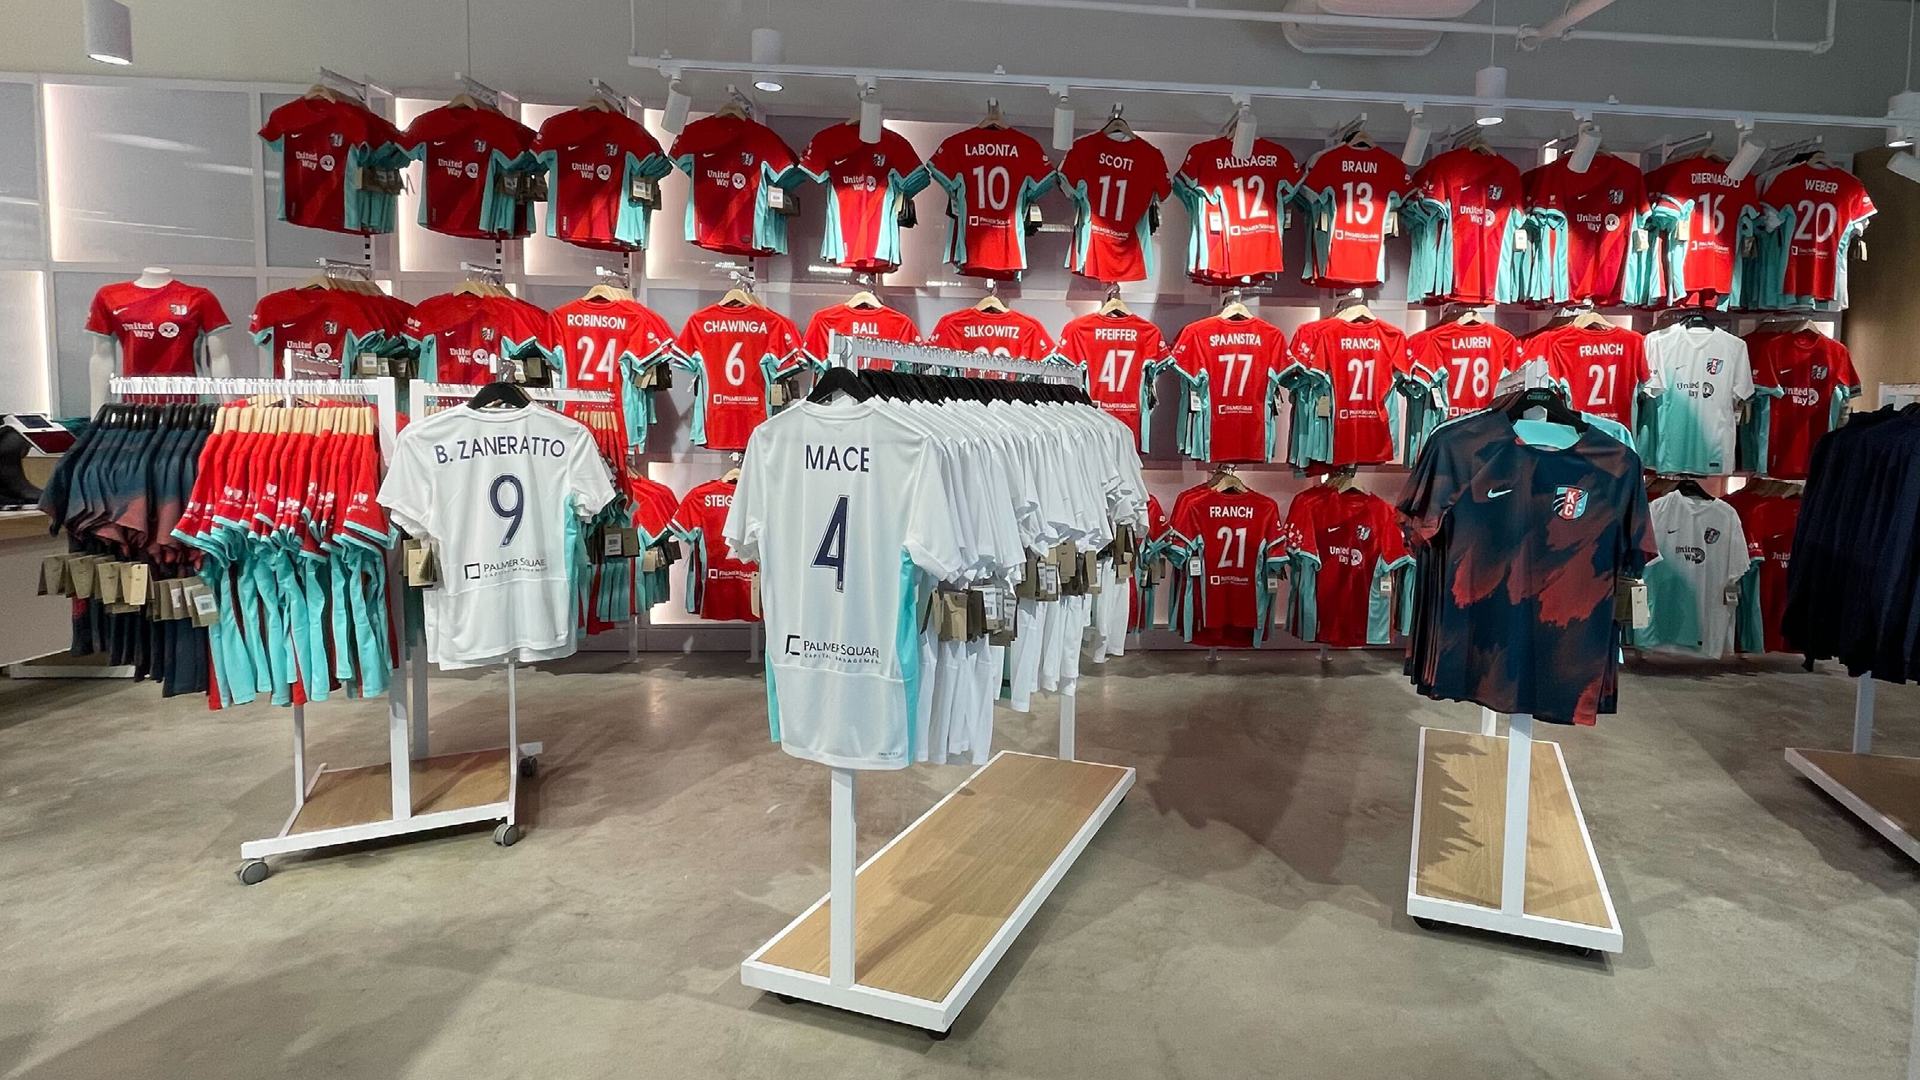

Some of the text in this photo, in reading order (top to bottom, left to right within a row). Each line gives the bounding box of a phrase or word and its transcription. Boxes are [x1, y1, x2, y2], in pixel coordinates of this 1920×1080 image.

[438, 159, 462, 168] United
[572, 163, 594, 172] United
[1099, 153, 1133, 171] SCOTT
[1216, 155, 1277, 169] BALLISAGER
[1342, 161, 1377, 173] BRAUN
[447, 167, 462, 178] Way
[581, 170, 593, 180] Way
[708, 170, 729, 179] United
[717, 178, 729, 187] Way
[973, 166, 1009, 210] 10
[1806, 179, 1838, 194] WEBER
[1099, 176, 1127, 221] 11
[1232, 175, 1268, 219] 12
[1343, 181, 1374, 225] 13
[1699, 192, 1725, 236] 16
[1796, 200, 1837, 243] 20
[568, 314, 626, 329] ROBINSON
[704, 320, 767, 334] CHAWINGA
[853, 322, 879, 335] BALL
[133, 330, 154, 339] Way
[964, 325, 1019, 339] SILKOWITZ
[1095, 329, 1137, 341] PFEIFFER
[1210, 333, 1261, 346] SPAANSTRA
[285, 341, 312, 350] United
[1341, 338, 1380, 351] FRANCH
[1452, 337, 1491, 349] LAUREN
[1580, 343, 1623, 357] FRANCH
[577, 336, 617, 382] 24
[725, 342, 744, 386] 6
[1099, 350, 1135, 392] 47
[1219, 353, 1253, 396] 77
[1452, 357, 1489, 399] 78
[1348, 358, 1375, 400] 21
[1588, 365, 1616, 405] 21
[434, 436, 565, 464] B. ZANERATTO
[806, 445, 869, 472] MACE
[488, 473, 525, 548] 9
[1210, 506, 1253, 518] FRANCH
[810, 494, 850, 593] 4
[1217, 526, 1246, 568] 21
[484, 559, 519, 572] PALMER
